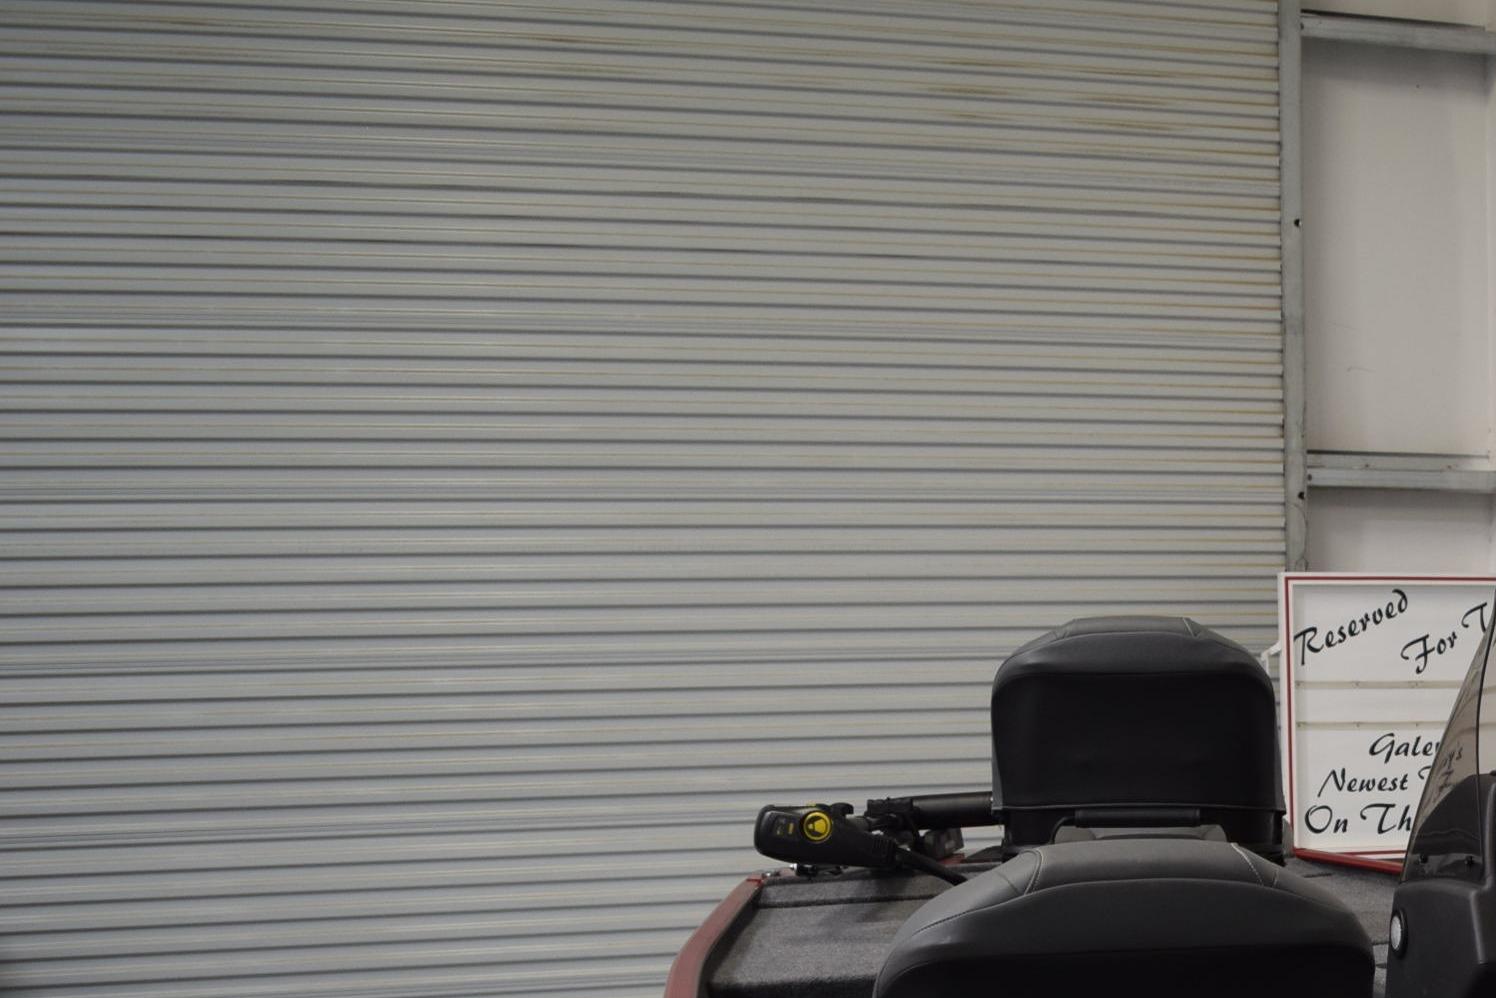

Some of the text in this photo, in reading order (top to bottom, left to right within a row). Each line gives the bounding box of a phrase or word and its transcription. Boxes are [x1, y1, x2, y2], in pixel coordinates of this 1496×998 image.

[1294, 588, 1409, 666] Reserved
[1400, 629, 1458, 675] For
[1316, 767, 1408, 798] Newest
[1304, 803, 1413, 834] On Th
